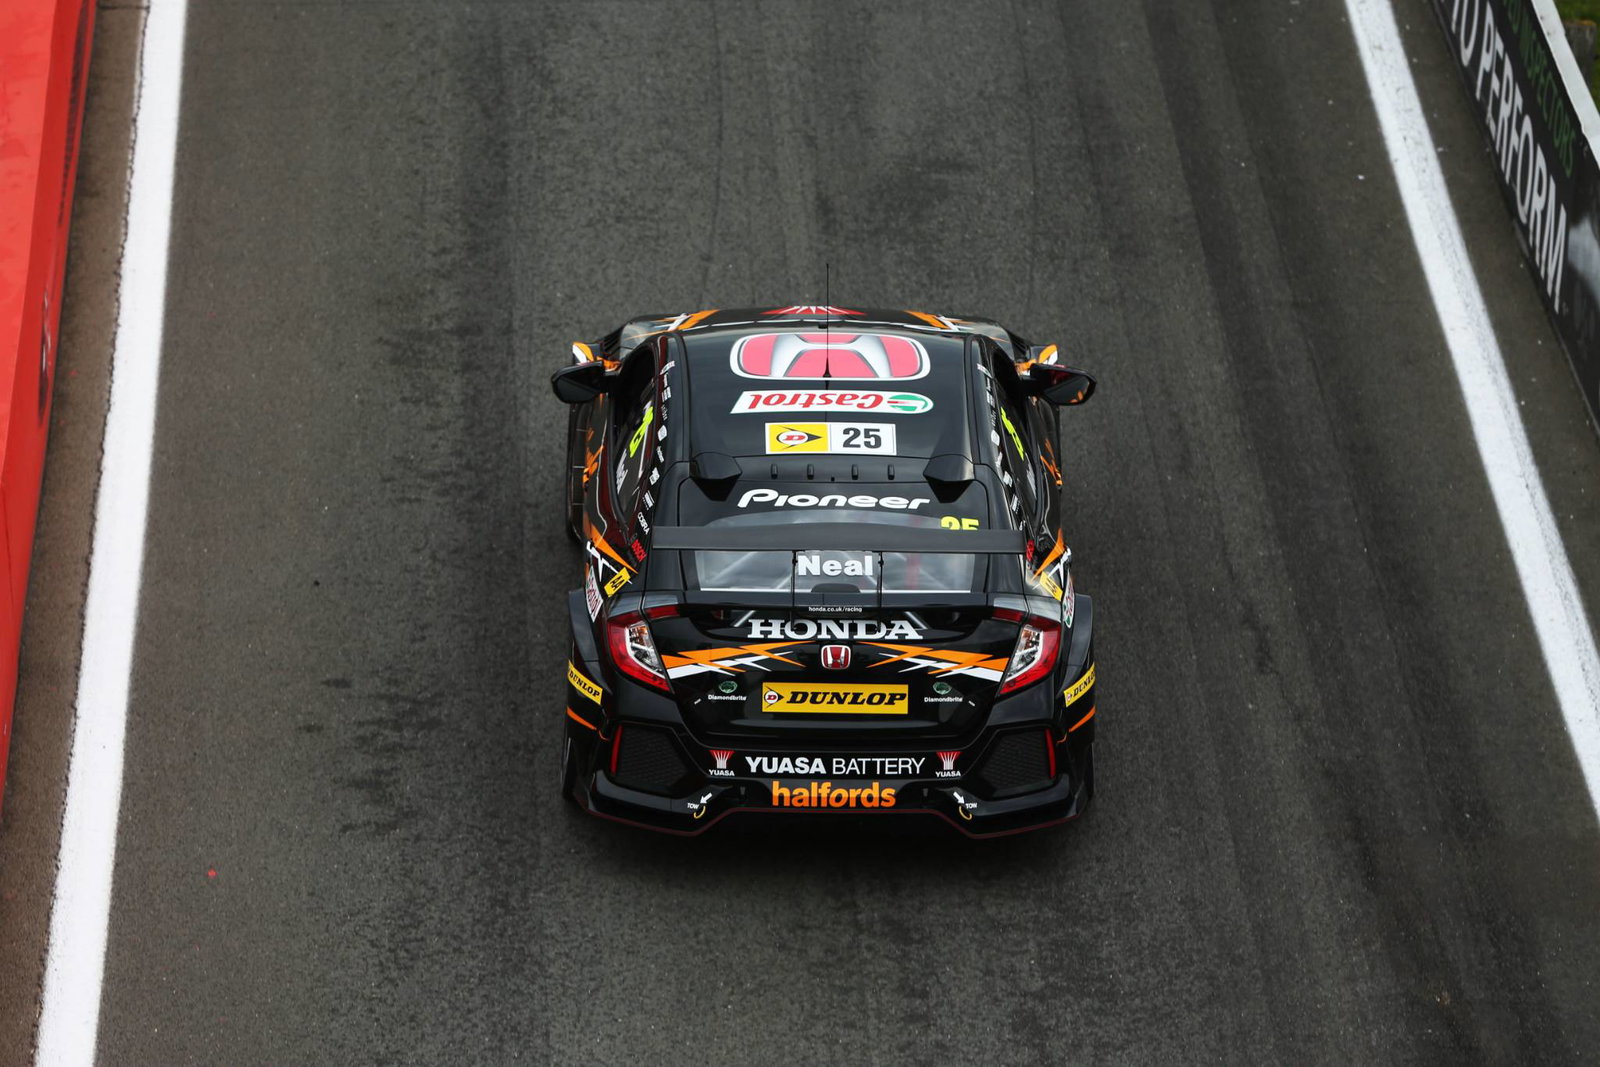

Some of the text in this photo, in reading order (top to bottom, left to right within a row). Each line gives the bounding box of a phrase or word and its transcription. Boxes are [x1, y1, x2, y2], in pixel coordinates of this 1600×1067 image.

[1476, 1, 1567, 314] PERFORM
[747, 393, 884, 410] Castrol
[842, 427, 882, 449] 25
[737, 489, 930, 509] Pioneer
[798, 555, 873, 576] Neal
[808, 606, 863, 614] honda.co.uk/racing
[747, 619, 923, 640] HONDA
[568, 669, 600, 698] DUNLOP
[786, 691, 907, 706] DUNLOP
[708, 769, 735, 777] YUASA
[745, 757, 925, 775] YUASA BATTERY
[935, 770, 961, 778] YUASA
[772, 781, 896, 807] halfords
[687, 802, 699, 810] TOW
